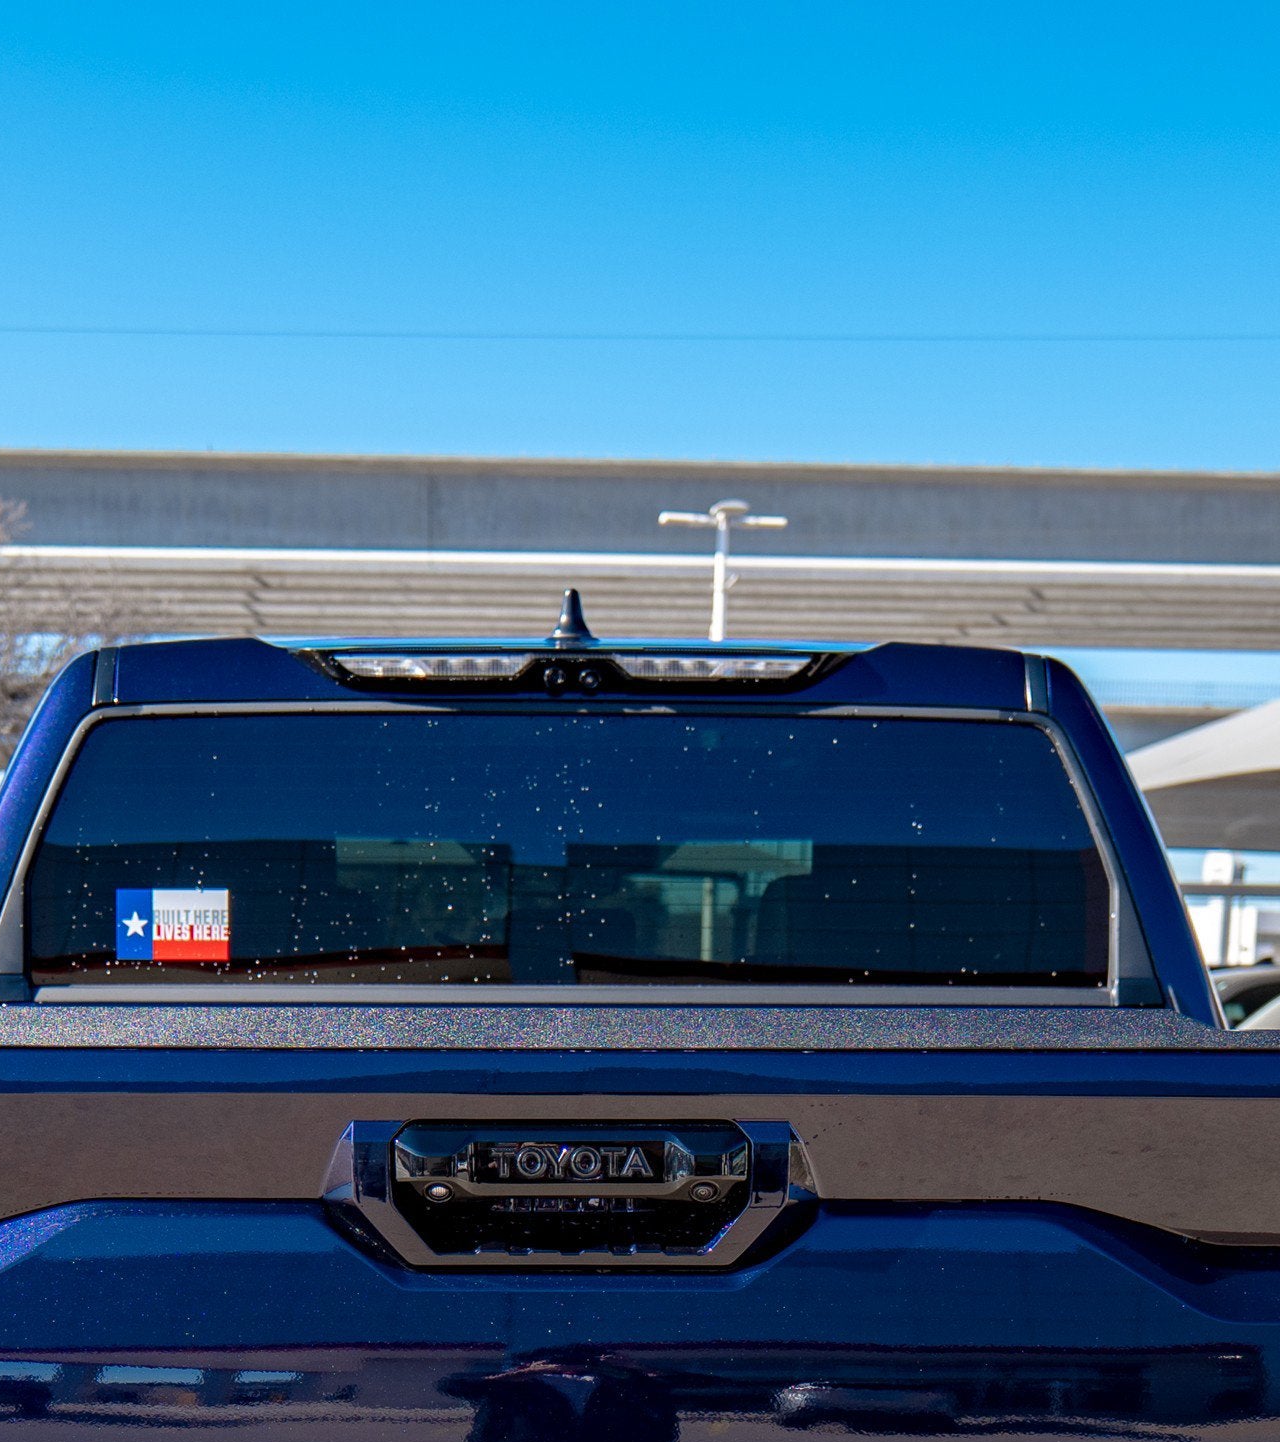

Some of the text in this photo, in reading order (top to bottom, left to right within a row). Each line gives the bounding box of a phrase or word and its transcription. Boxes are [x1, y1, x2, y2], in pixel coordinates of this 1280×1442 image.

[153, 909, 229, 926] BUILT HERE
[153, 924, 229, 941] LIVES HERE
[491, 1145, 655, 1181] TOYOTA
